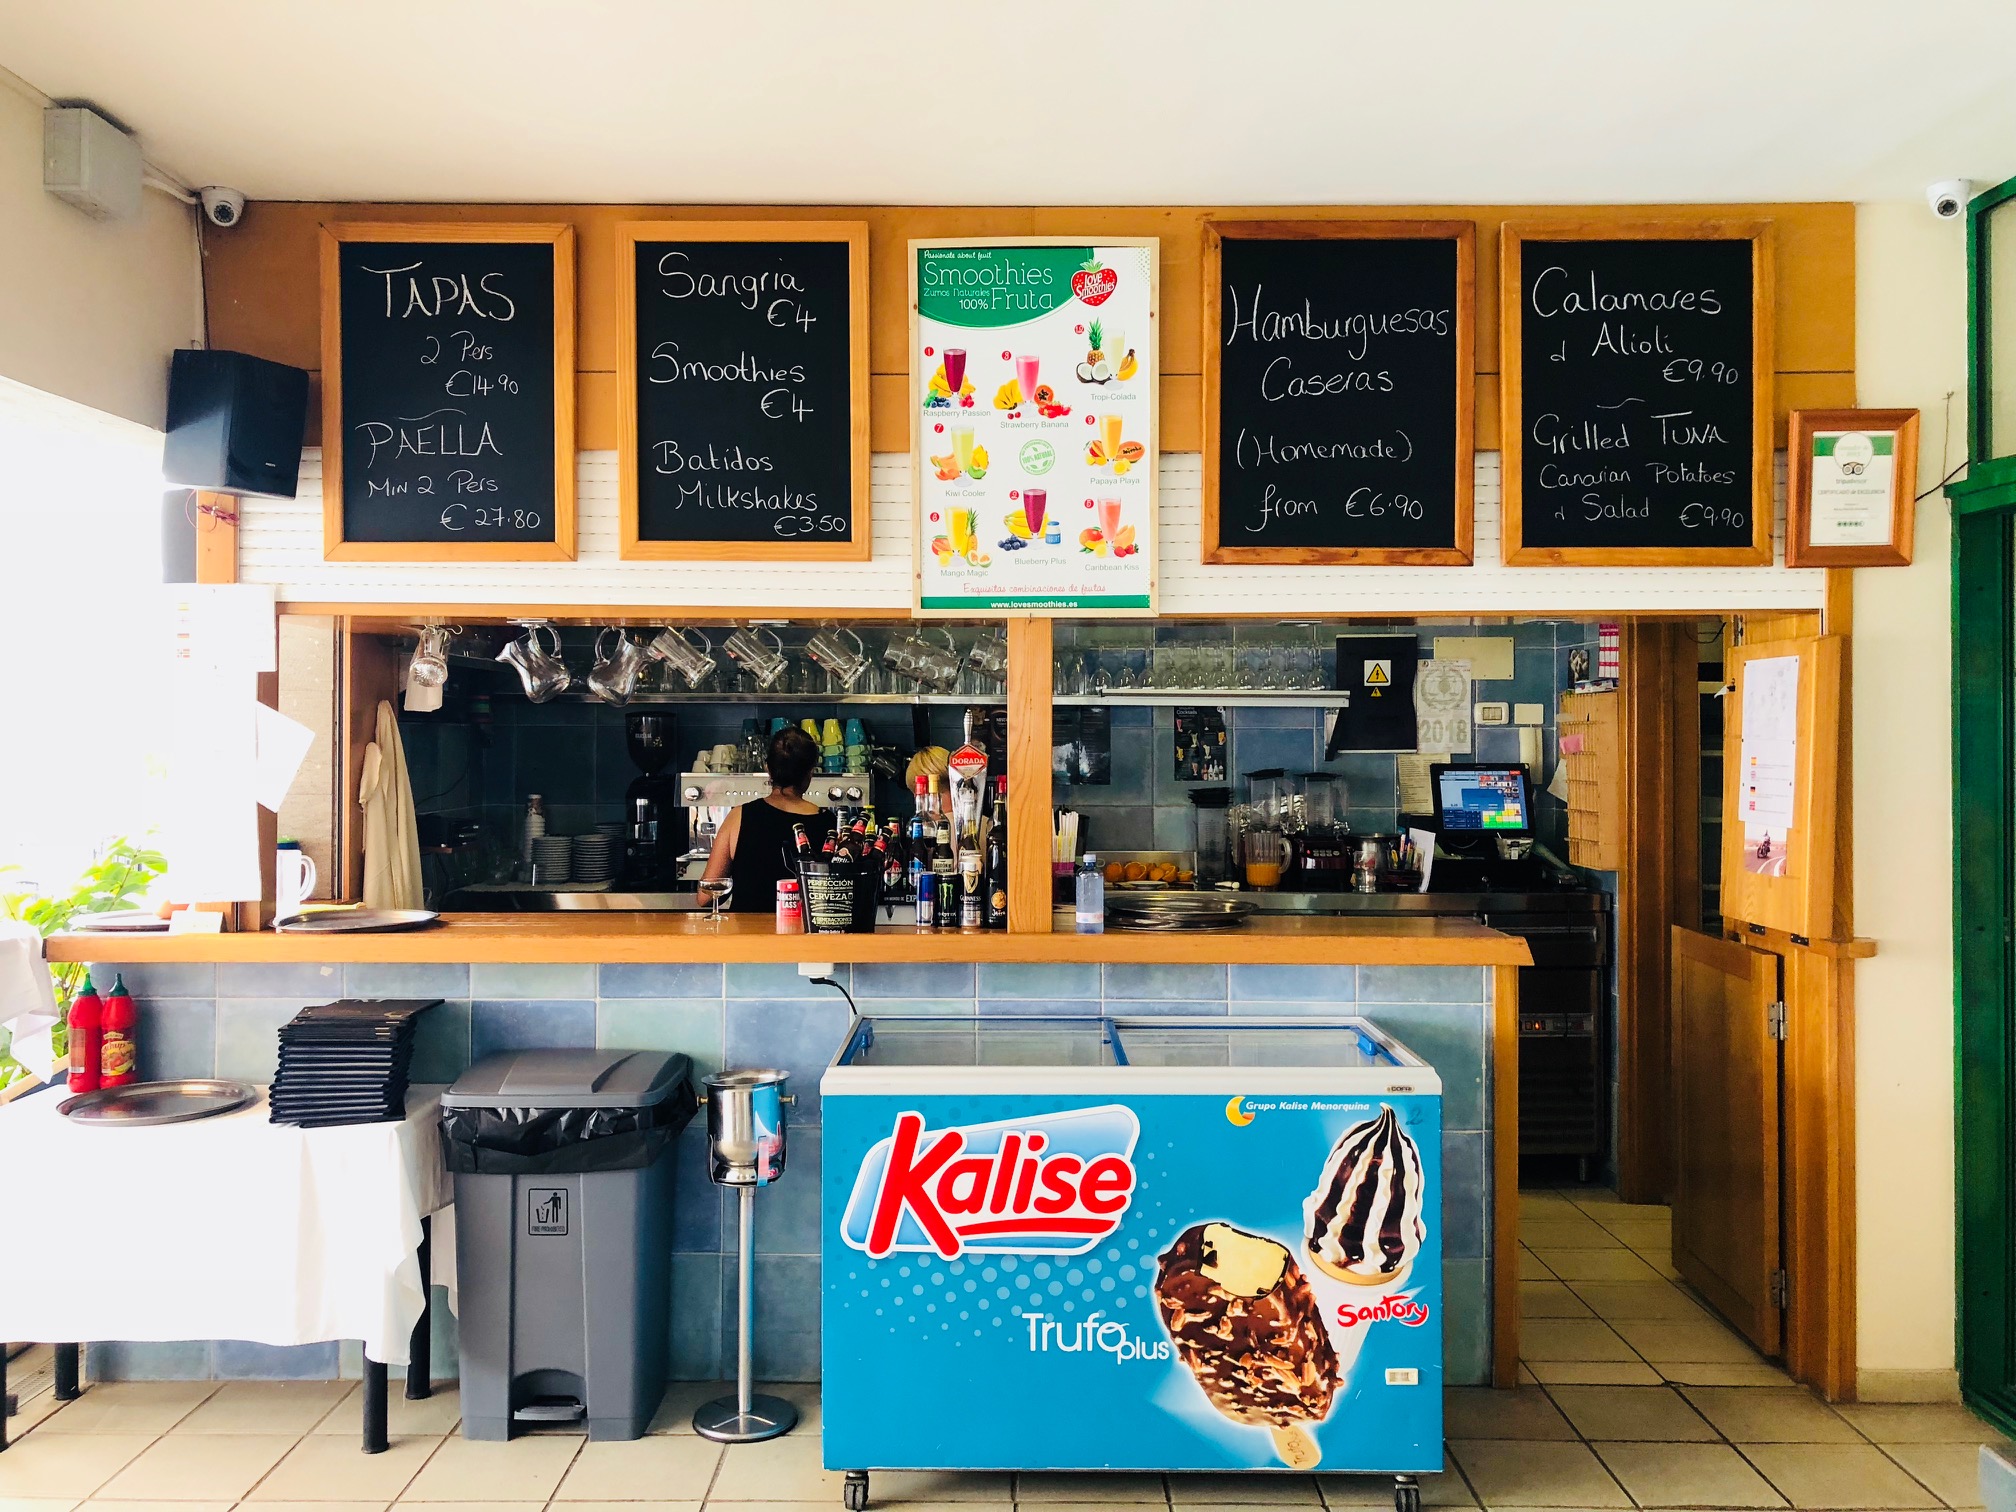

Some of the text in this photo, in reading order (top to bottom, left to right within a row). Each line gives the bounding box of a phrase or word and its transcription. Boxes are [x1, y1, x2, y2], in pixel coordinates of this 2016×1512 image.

[957, 250, 975, 259] about
[977, 251, 992, 260] fruit
[658, 251, 805, 311] Sangria
[924, 259, 1053, 286] Smoothies
[360, 261, 515, 322] TAPAS
[924, 288, 990, 297] Zumos Naturales
[958, 288, 1054, 310] 100% Fruta
[1076, 281, 1115, 299] Smoothies
[1532, 266, 1722, 318] Calamares
[767, 299, 817, 334] €4
[1227, 283, 1450, 361] Hamburguesas
[420, 330, 493, 364] 2 Pers
[1592, 321, 1674, 357] Alioli
[649, 341, 807, 385] Smoothies
[1662, 358, 1739, 385] €9.90
[1261, 356, 1395, 402] Caseras
[760, 388, 815, 423] €4
[1091, 393, 1137, 401] Tropi-Colada
[923, 409, 991, 418] Raspberry Passion
[1000, 420, 1069, 430] Strawberry Banana
[355, 421, 503, 469] PAELLA
[1533, 413, 1630, 454] Grilled
[652, 440, 774, 475] Batidos
[1236, 428, 1413, 469] (Homemade)
[417, 475, 435, 495] 2
[447, 469, 499, 494] Pers
[1090, 477, 1140, 486] Papaya Playa
[1539, 461, 1736, 489] Canarian Potatoes
[675, 480, 819, 512] Milkshakes
[945, 489, 986, 497] Kiwi Cooler
[1245, 483, 1318, 532] from
[1581, 493, 1650, 521] Salad
[1678, 502, 1745, 528] €9.90
[773, 515, 847, 537] €3.50
[940, 569, 989, 578] Mango Magic
[1014, 557, 1067, 566] Blueberry Plus
[1085, 563, 1140, 571] Caribbean Kiss
[963, 582, 1106, 596] Exquisitas combinaciones de frutas
[991, 600, 1078, 609] www.lovesmoothies.es
[1419, 720, 1468, 743] 2018
[952, 757, 985, 765] DORADA
[807, 879, 853, 887] PERFECCIÓN
[808, 892, 847, 900] CERVEZA
[1246, 1101, 1371, 1111] Grupo Kalise Menorquina
[869, 1115, 1132, 1257] Kalise
[1117, 1336, 1170, 1365] plus
